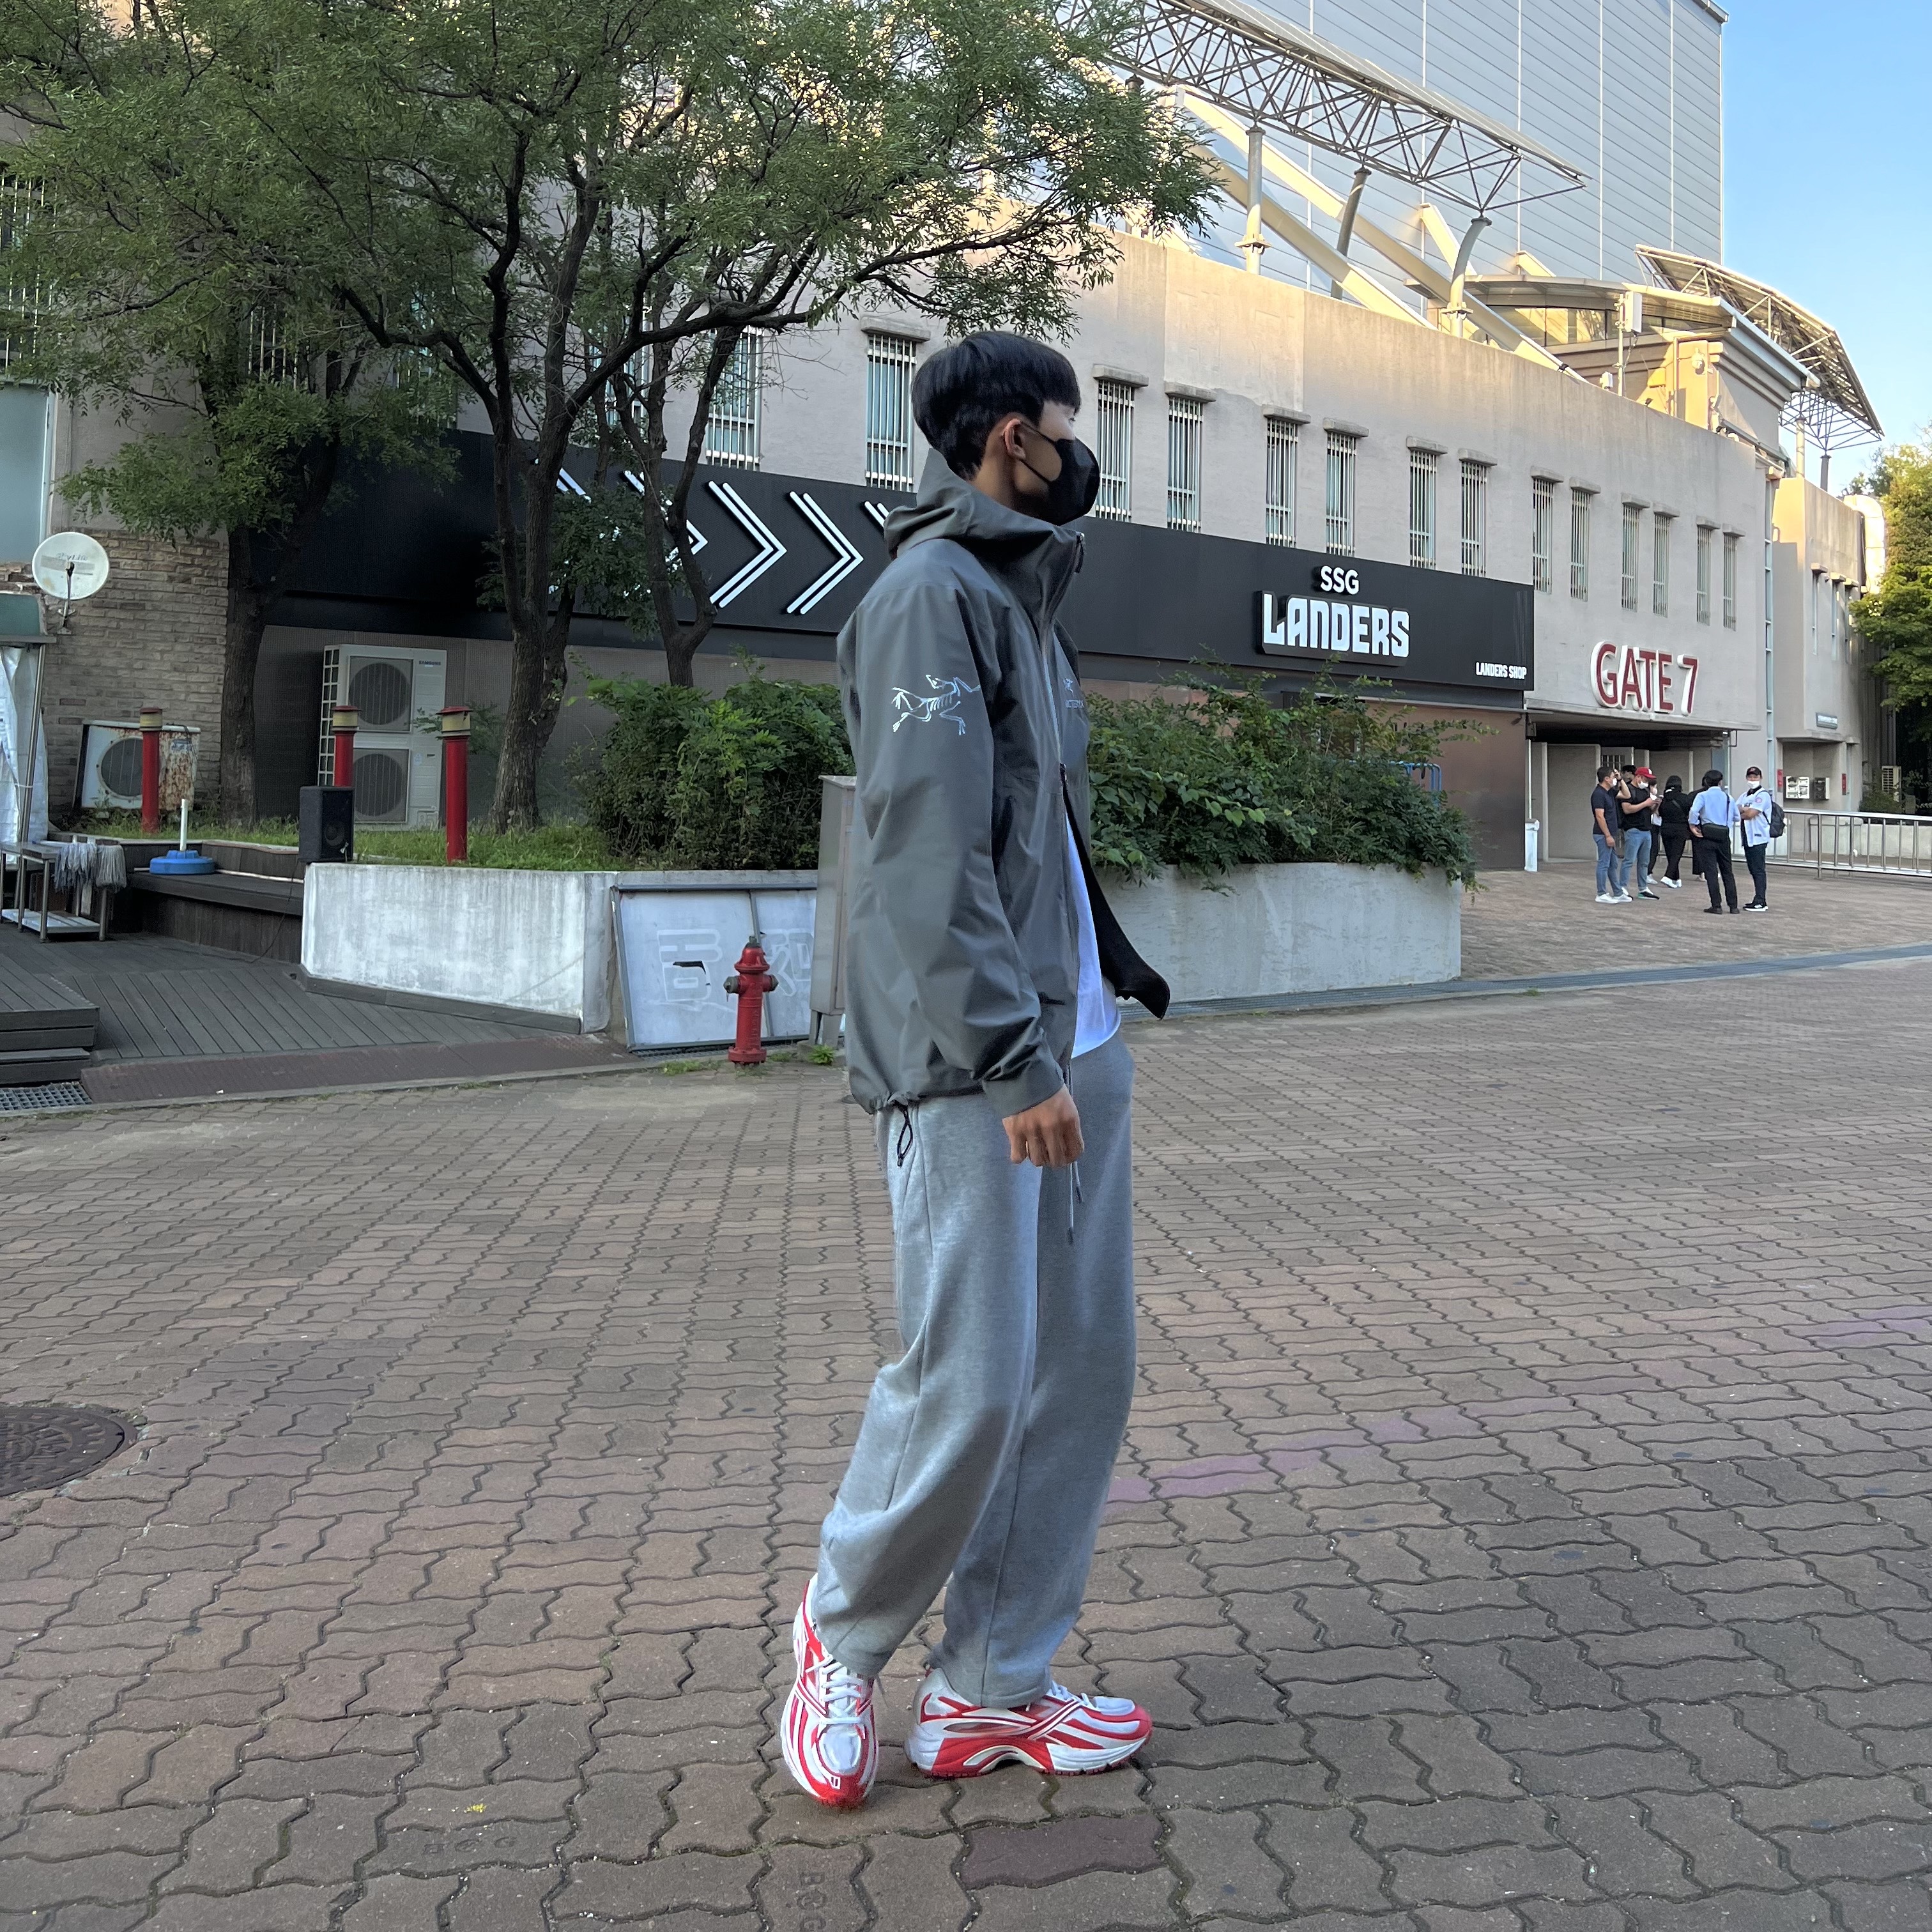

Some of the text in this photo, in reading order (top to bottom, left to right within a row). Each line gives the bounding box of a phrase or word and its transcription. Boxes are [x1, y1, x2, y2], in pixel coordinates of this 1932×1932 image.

[1320, 565, 1360, 595] SSG
[1263, 594, 1409, 657] LANDERS
[1476, 661, 1527, 680] LANDERS SHOP
[1591, 641, 1699, 716] GATE 7
